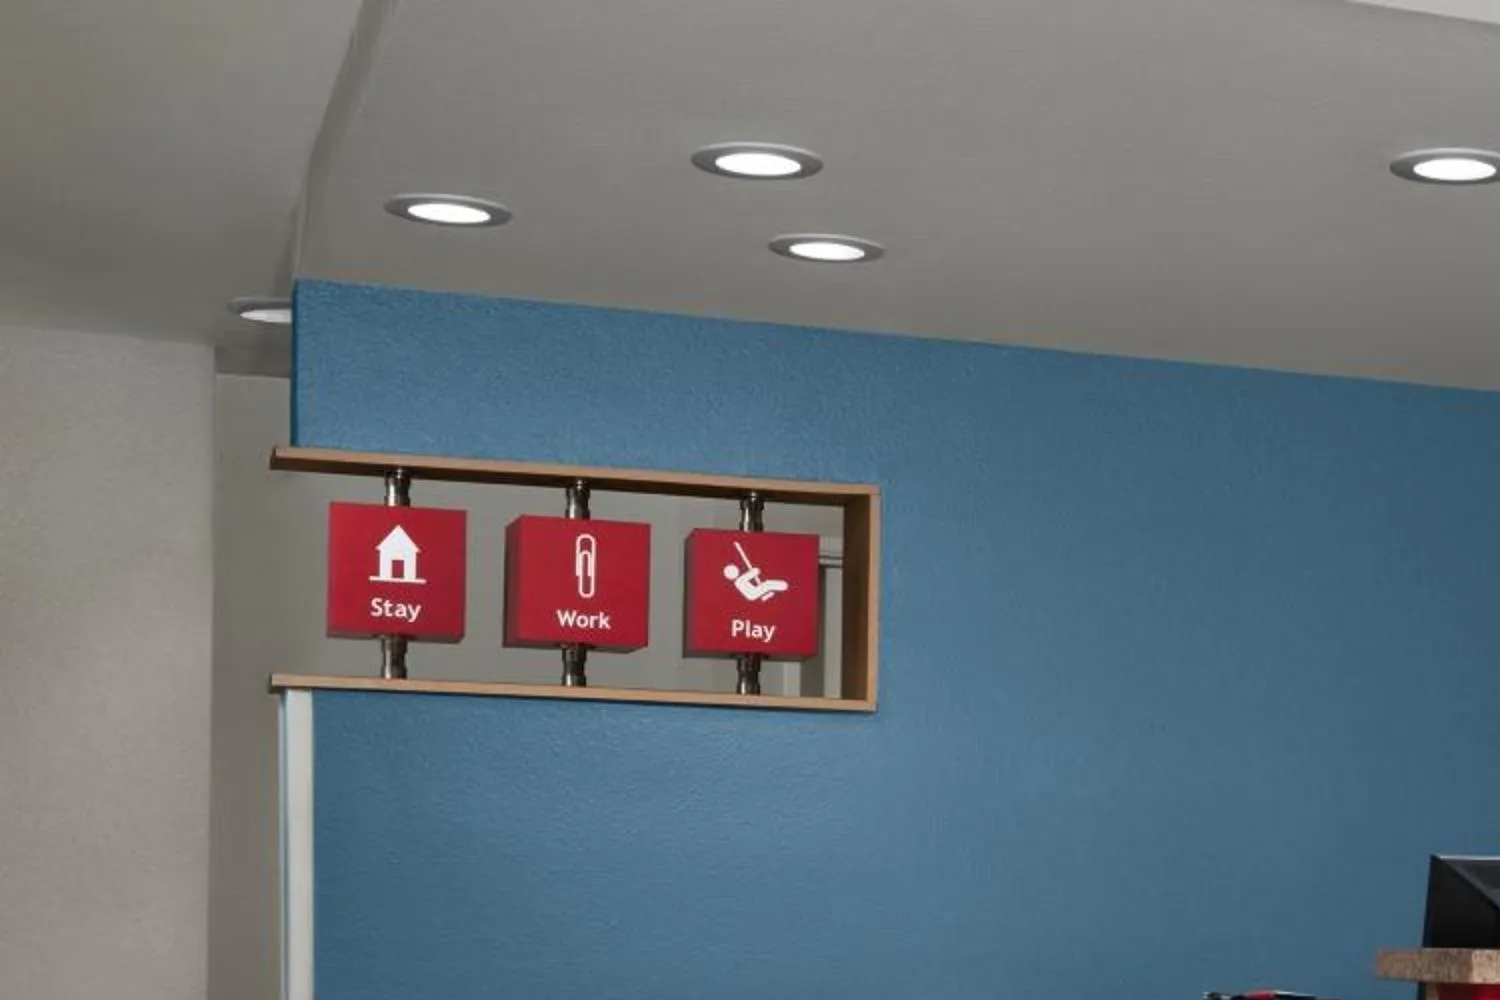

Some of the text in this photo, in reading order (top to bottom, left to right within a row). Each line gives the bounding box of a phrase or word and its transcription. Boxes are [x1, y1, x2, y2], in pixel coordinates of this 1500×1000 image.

[370, 597, 421, 622] Stay
[557, 609, 611, 630] Work
[731, 619, 776, 642] Play
